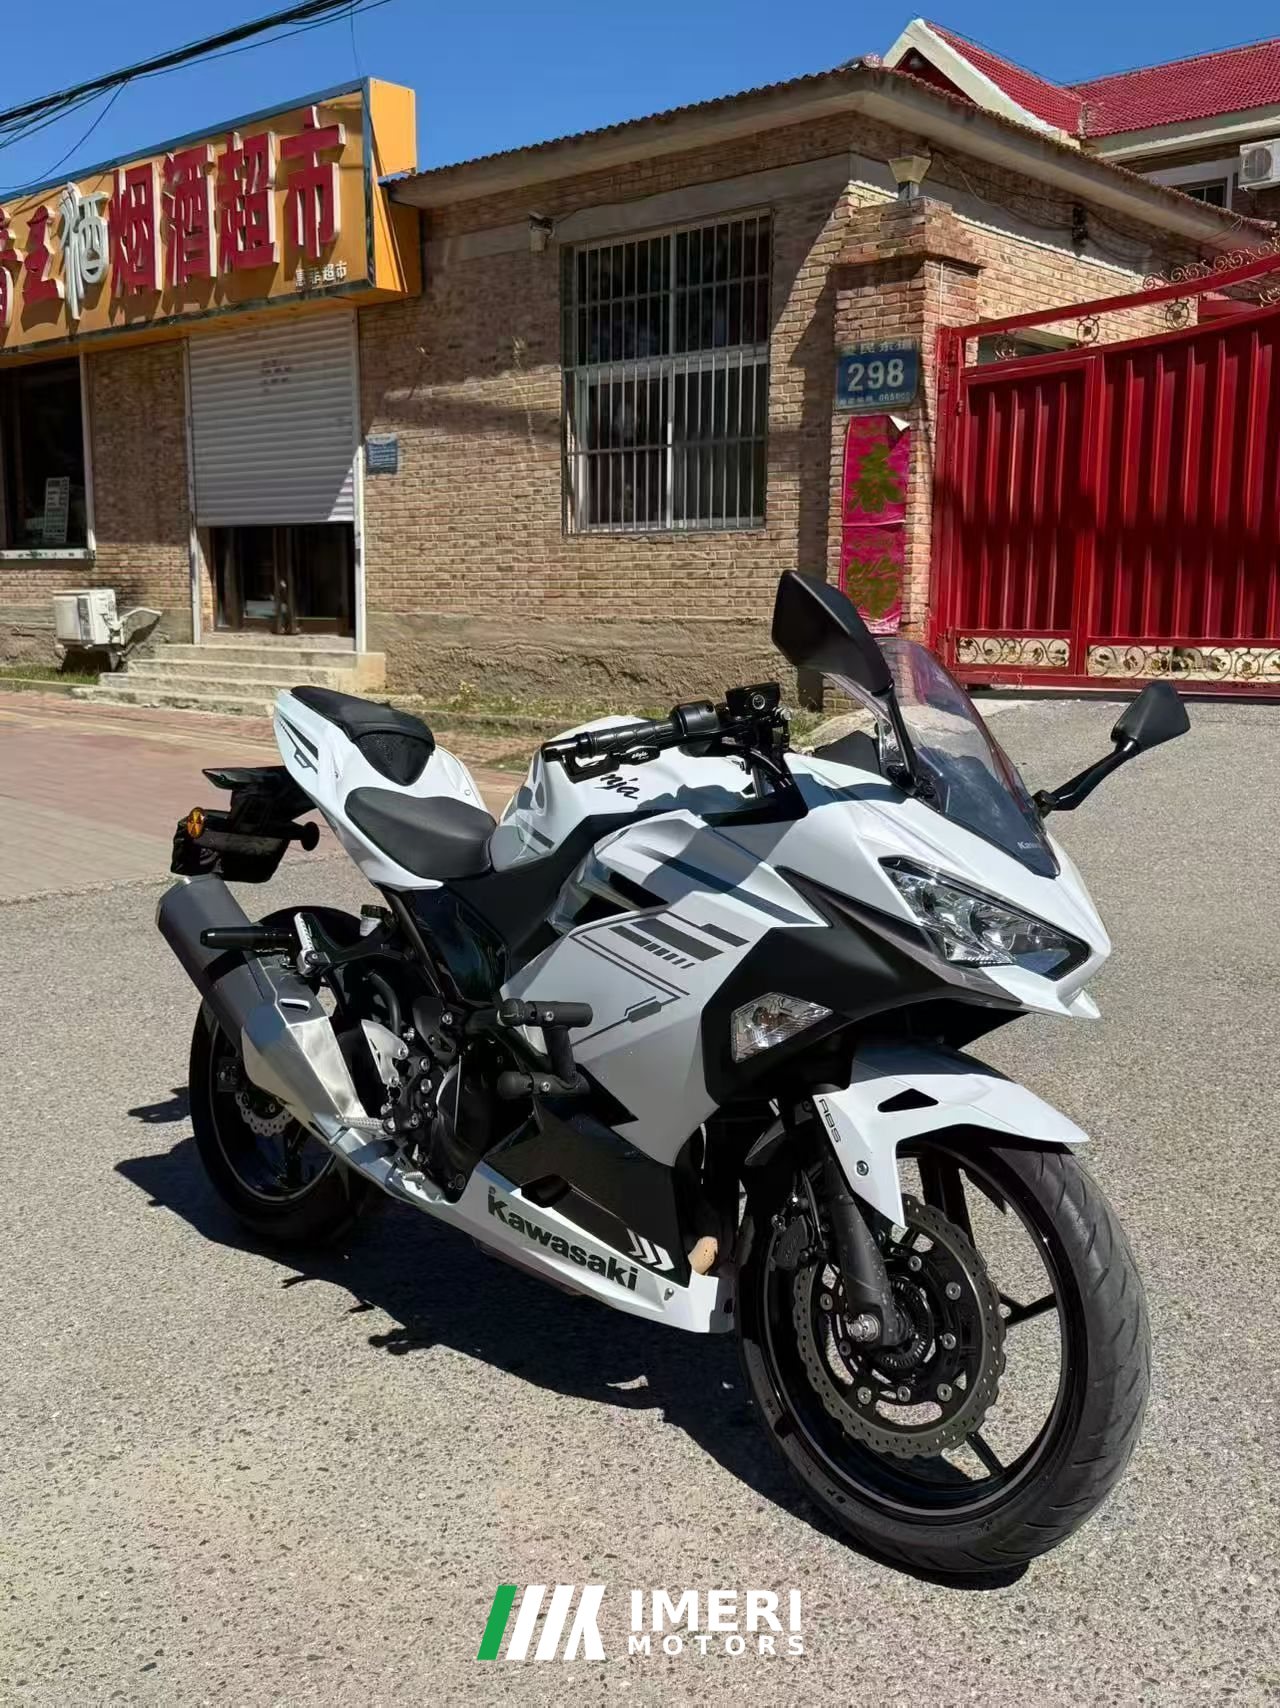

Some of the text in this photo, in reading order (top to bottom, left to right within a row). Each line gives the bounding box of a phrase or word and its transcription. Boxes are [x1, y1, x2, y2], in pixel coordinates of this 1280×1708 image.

[848, 359, 904, 392] 298
[818, 1098, 842, 1143] ABS
[487, 1191, 639, 1291] Kawasaki
